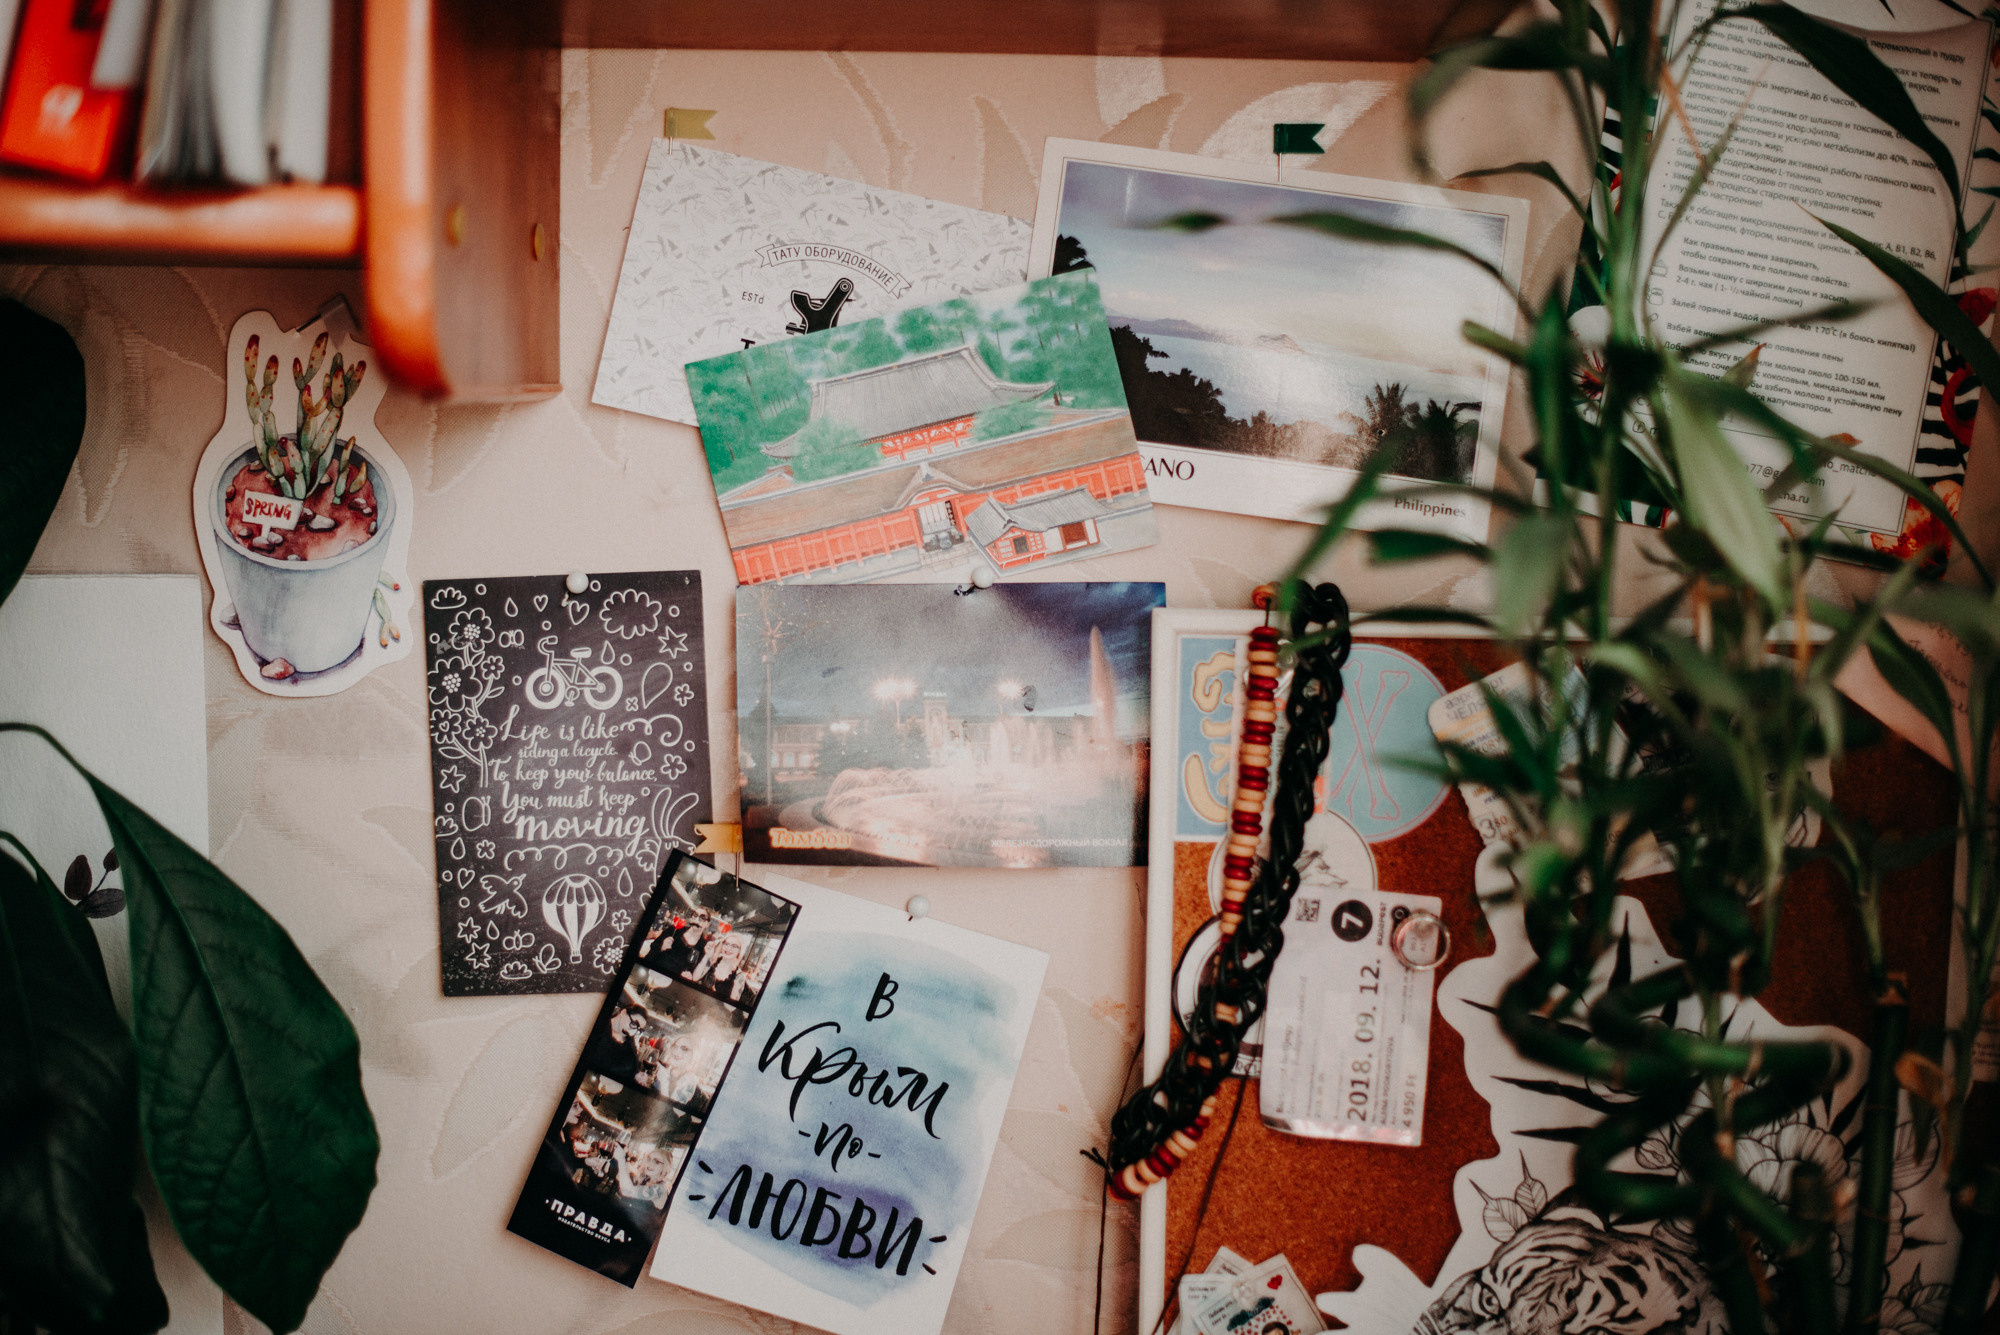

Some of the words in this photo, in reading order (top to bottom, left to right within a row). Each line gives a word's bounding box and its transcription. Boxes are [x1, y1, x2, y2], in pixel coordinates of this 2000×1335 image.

[1707, 57, 1749, 72] свойства:
[1731, 46, 1785, 64] насладиться
[1746, 37, 1761, 45] что
[1919, 71, 1949, 84] теперь
[1688, 79, 1747, 97] нервозности;
[1769, 83, 1809, 99] энергией
[1684, 102, 1727, 118] высокому
[1756, 105, 1797, 119] организм
[1810, 115, 1844, 128] шлаков
[1823, 141, 1874, 157] метаболизм
[1722, 158, 1777, 175] содержанию
[1735, 148, 1786, 165] стимуляции
[1830, 167, 1861, 179] работы
[1863, 174, 1908, 188] головного
[1710, 191, 1763, 208] настроение!
[1716, 181, 1757, 195] процессы
[1741, 174, 1775, 187] сосудов
[1788, 183, 1824, 195] плохого
[1825, 190, 1883, 208] холестерина;
[772, 247, 800, 262] ТАТУ
[804, 246, 893, 287] ОБОРУДОВАНИЕ
[1680, 248, 1706, 260] чтобы
[1707, 255, 1750, 270] сохранить
[1752, 263, 1765, 272] все
[1767, 266, 1808, 280] полезные
[1810, 273, 1850, 288] свойства:
[1683, 237, 1698, 246] Как
[1699, 241, 1744, 256] правильно
[1746, 250, 1768, 260] меня
[1770, 255, 1820, 271] заваривать,
[1678, 264, 1709, 276] Возьми
[1711, 271, 1737, 283] чашку
[1744, 277, 1785, 292] широким
[1786, 286, 1810, 297] дном
[1698, 281, 1713, 289] чая
[1671, 297, 1696, 309] Залей
[1697, 303, 1731, 317] горячей
[1732, 310, 1758, 322] водой
[1849, 331, 1876, 344] боюсь
[1774, 344, 1819, 358] появления
[1821, 353, 1844, 363] пены
[1762, 371, 1810, 387] кокосовым,
[1812, 381, 1867, 398] миндальным
[1870, 392, 1885, 401] или
[1775, 362, 1805, 374] молока
[1807, 369, 1832, 379] около
[1834, 373, 1865, 385] 100-150
[1764, 383, 1792, 395] взбить
[1793, 389, 1825, 401] молоко
[1833, 395, 1882, 413] устойчивую
[245, 497, 292, 520] SPRING
[1394, 498, 1466, 518] Philippines
[500, 705, 551, 749] Life
[560, 725, 574, 740] is
[581, 712, 620, 739] like
[518, 742, 559, 766] riding
[560, 748, 569, 757] a
[488, 756, 509, 781] To
[516, 759, 549, 789] keep
[555, 768, 593, 789] your
[597, 760, 657, 782] balance,
[502, 781, 543, 824] You
[547, 785, 593, 809] must
[600, 784, 637, 815] keep
[515, 811, 649, 857] moving
[769, 827, 853, 849] Тамбов
[991, 837, 1090, 849] ЖЕЛЕЗНОДОРОЖНЫЙ
[1092, 837, 1128, 848] ВОКЗАЛ
[1340, 911, 1364, 930] 7
[1360, 958, 1381, 995] 12.
[865, 972, 899, 1022] В
[1355, 1006, 1377, 1044] 09.
[758, 1019, 949, 1140] Крым
[1347, 1052, 1373, 1122] 2018.
[708, 1164, 924, 1277] ЛЮБВИ
